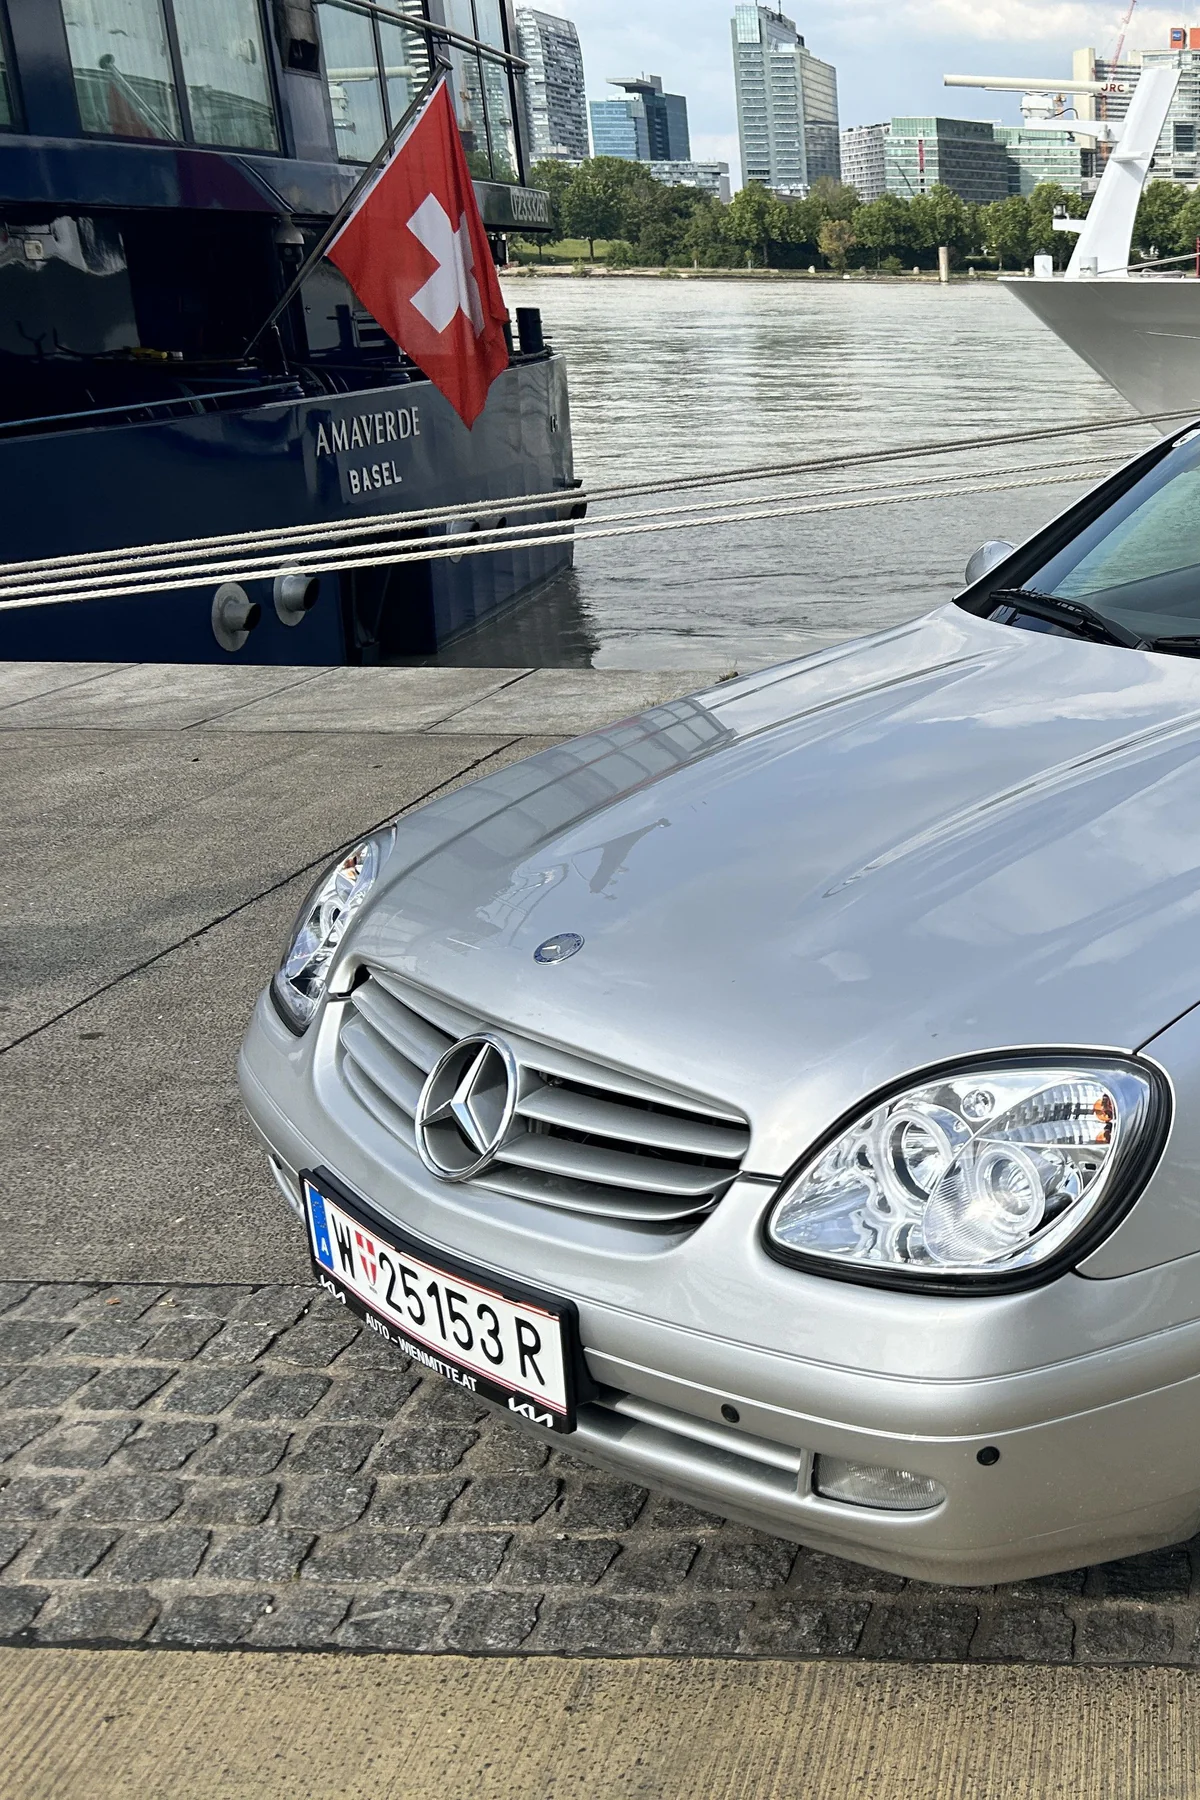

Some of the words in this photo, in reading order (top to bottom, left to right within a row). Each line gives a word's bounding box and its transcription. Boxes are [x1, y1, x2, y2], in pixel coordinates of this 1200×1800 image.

[1101, 83, 1125, 92] JRC
[316, 405, 421, 457] AMAVERDE
[349, 460, 403, 495] BASEL
[321, 1237, 330, 1256] A
[331, 1213, 356, 1280] W
[379, 1252, 504, 1365] 25153
[365, 1312, 390, 1340] AUTO
[397, 1336, 478, 1392] WIENMITTE.AT
